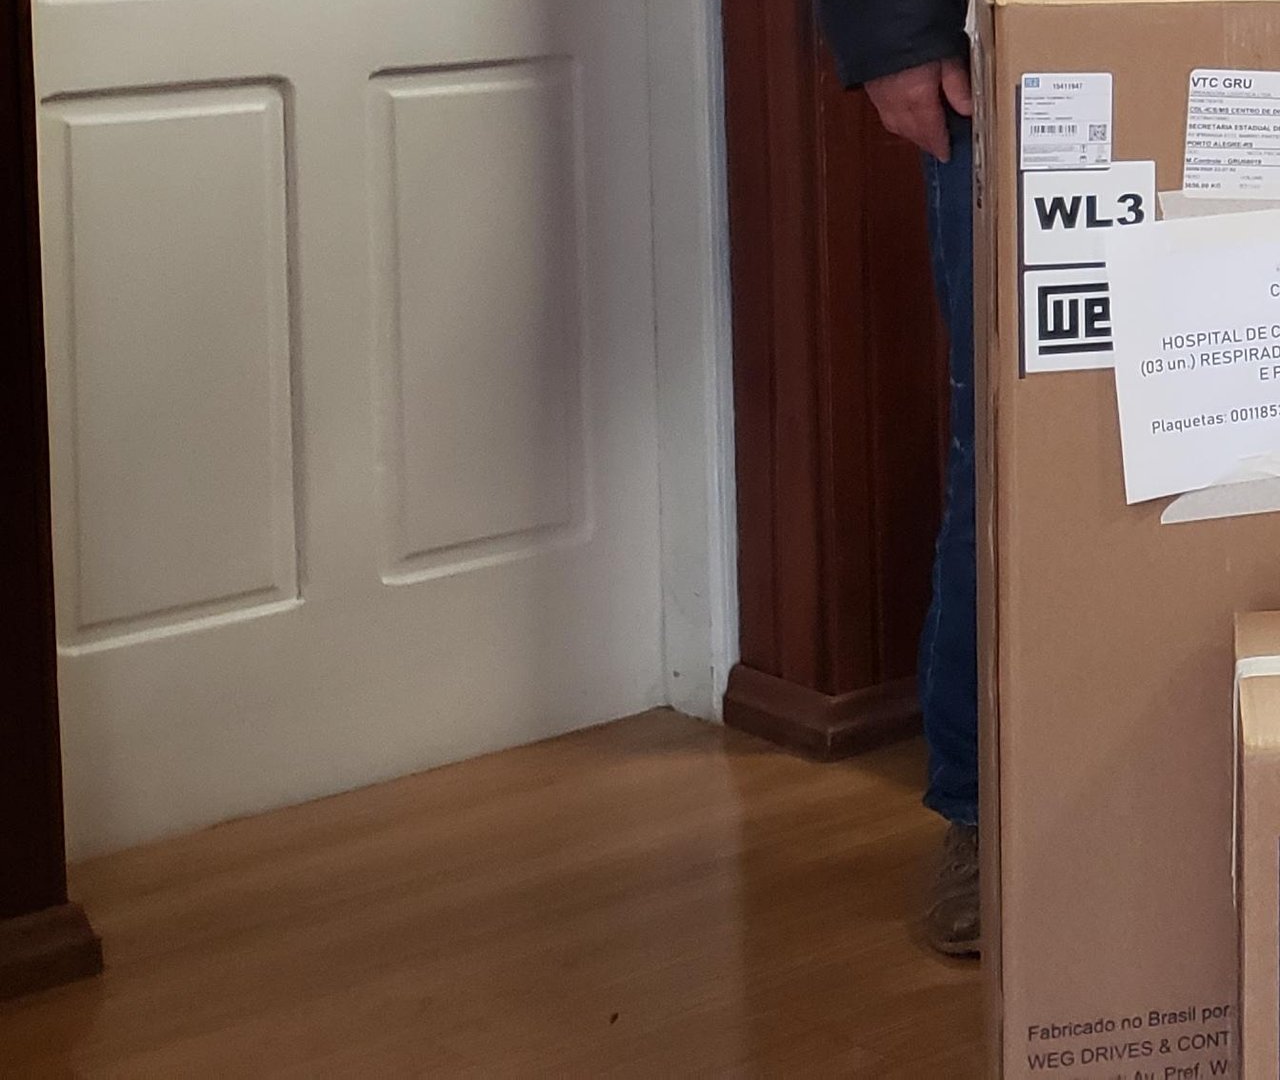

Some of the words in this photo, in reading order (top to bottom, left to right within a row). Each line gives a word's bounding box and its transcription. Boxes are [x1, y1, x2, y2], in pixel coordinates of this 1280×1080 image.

[1191, 77, 1218, 88] VTC
[1222, 78, 1253, 89] GRU
[1034, 193, 1144, 230] WL3
[1162, 329, 1242, 351] HOSPITAL
[1246, 326, 1268, 341] DE
[1141, 359, 1163, 378] (03
[1166, 353, 1195, 373] un.)
[1260, 367, 1270, 380] E
[1152, 414, 1227, 434] Plaquetas:
[1027, 1018, 1115, 1041] Fabricado
[1121, 1015, 1142, 1030] no
[1148, 1006, 1196, 1027] Brasil
[1201, 1005, 1230, 1023] por
[1027, 1051, 1075, 1070] WEG
[1081, 1040, 1153, 1064] DRIVES
[1159, 1038, 1171, 1054] &
